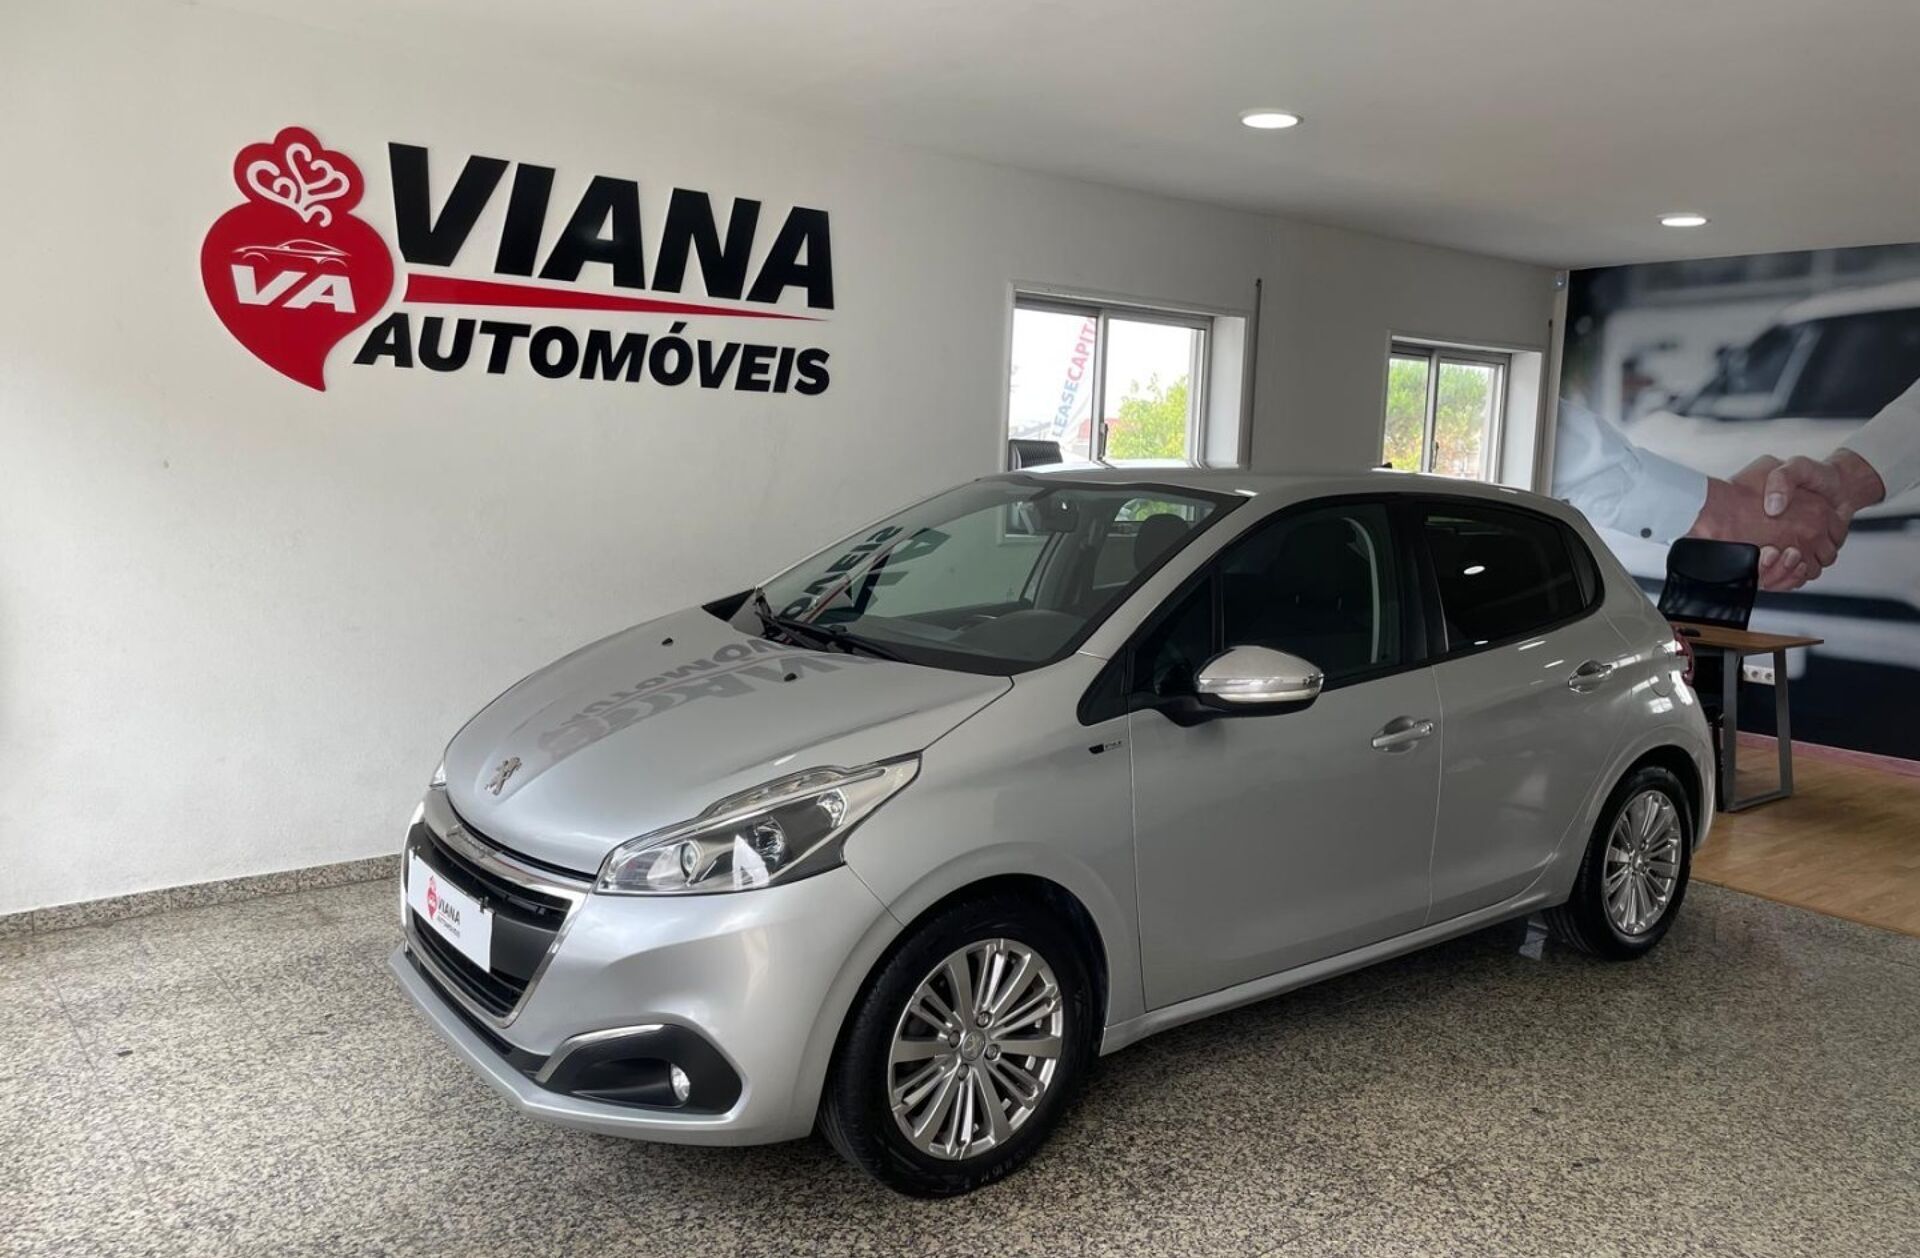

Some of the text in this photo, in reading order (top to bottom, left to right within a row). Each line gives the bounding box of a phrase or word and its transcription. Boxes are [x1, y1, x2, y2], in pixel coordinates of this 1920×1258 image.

[388, 142, 835, 310] VIANA
[231, 264, 356, 313] VA
[353, 313, 830, 396] AUTOMÓVEIS
[438, 897, 460, 924] VIANA
